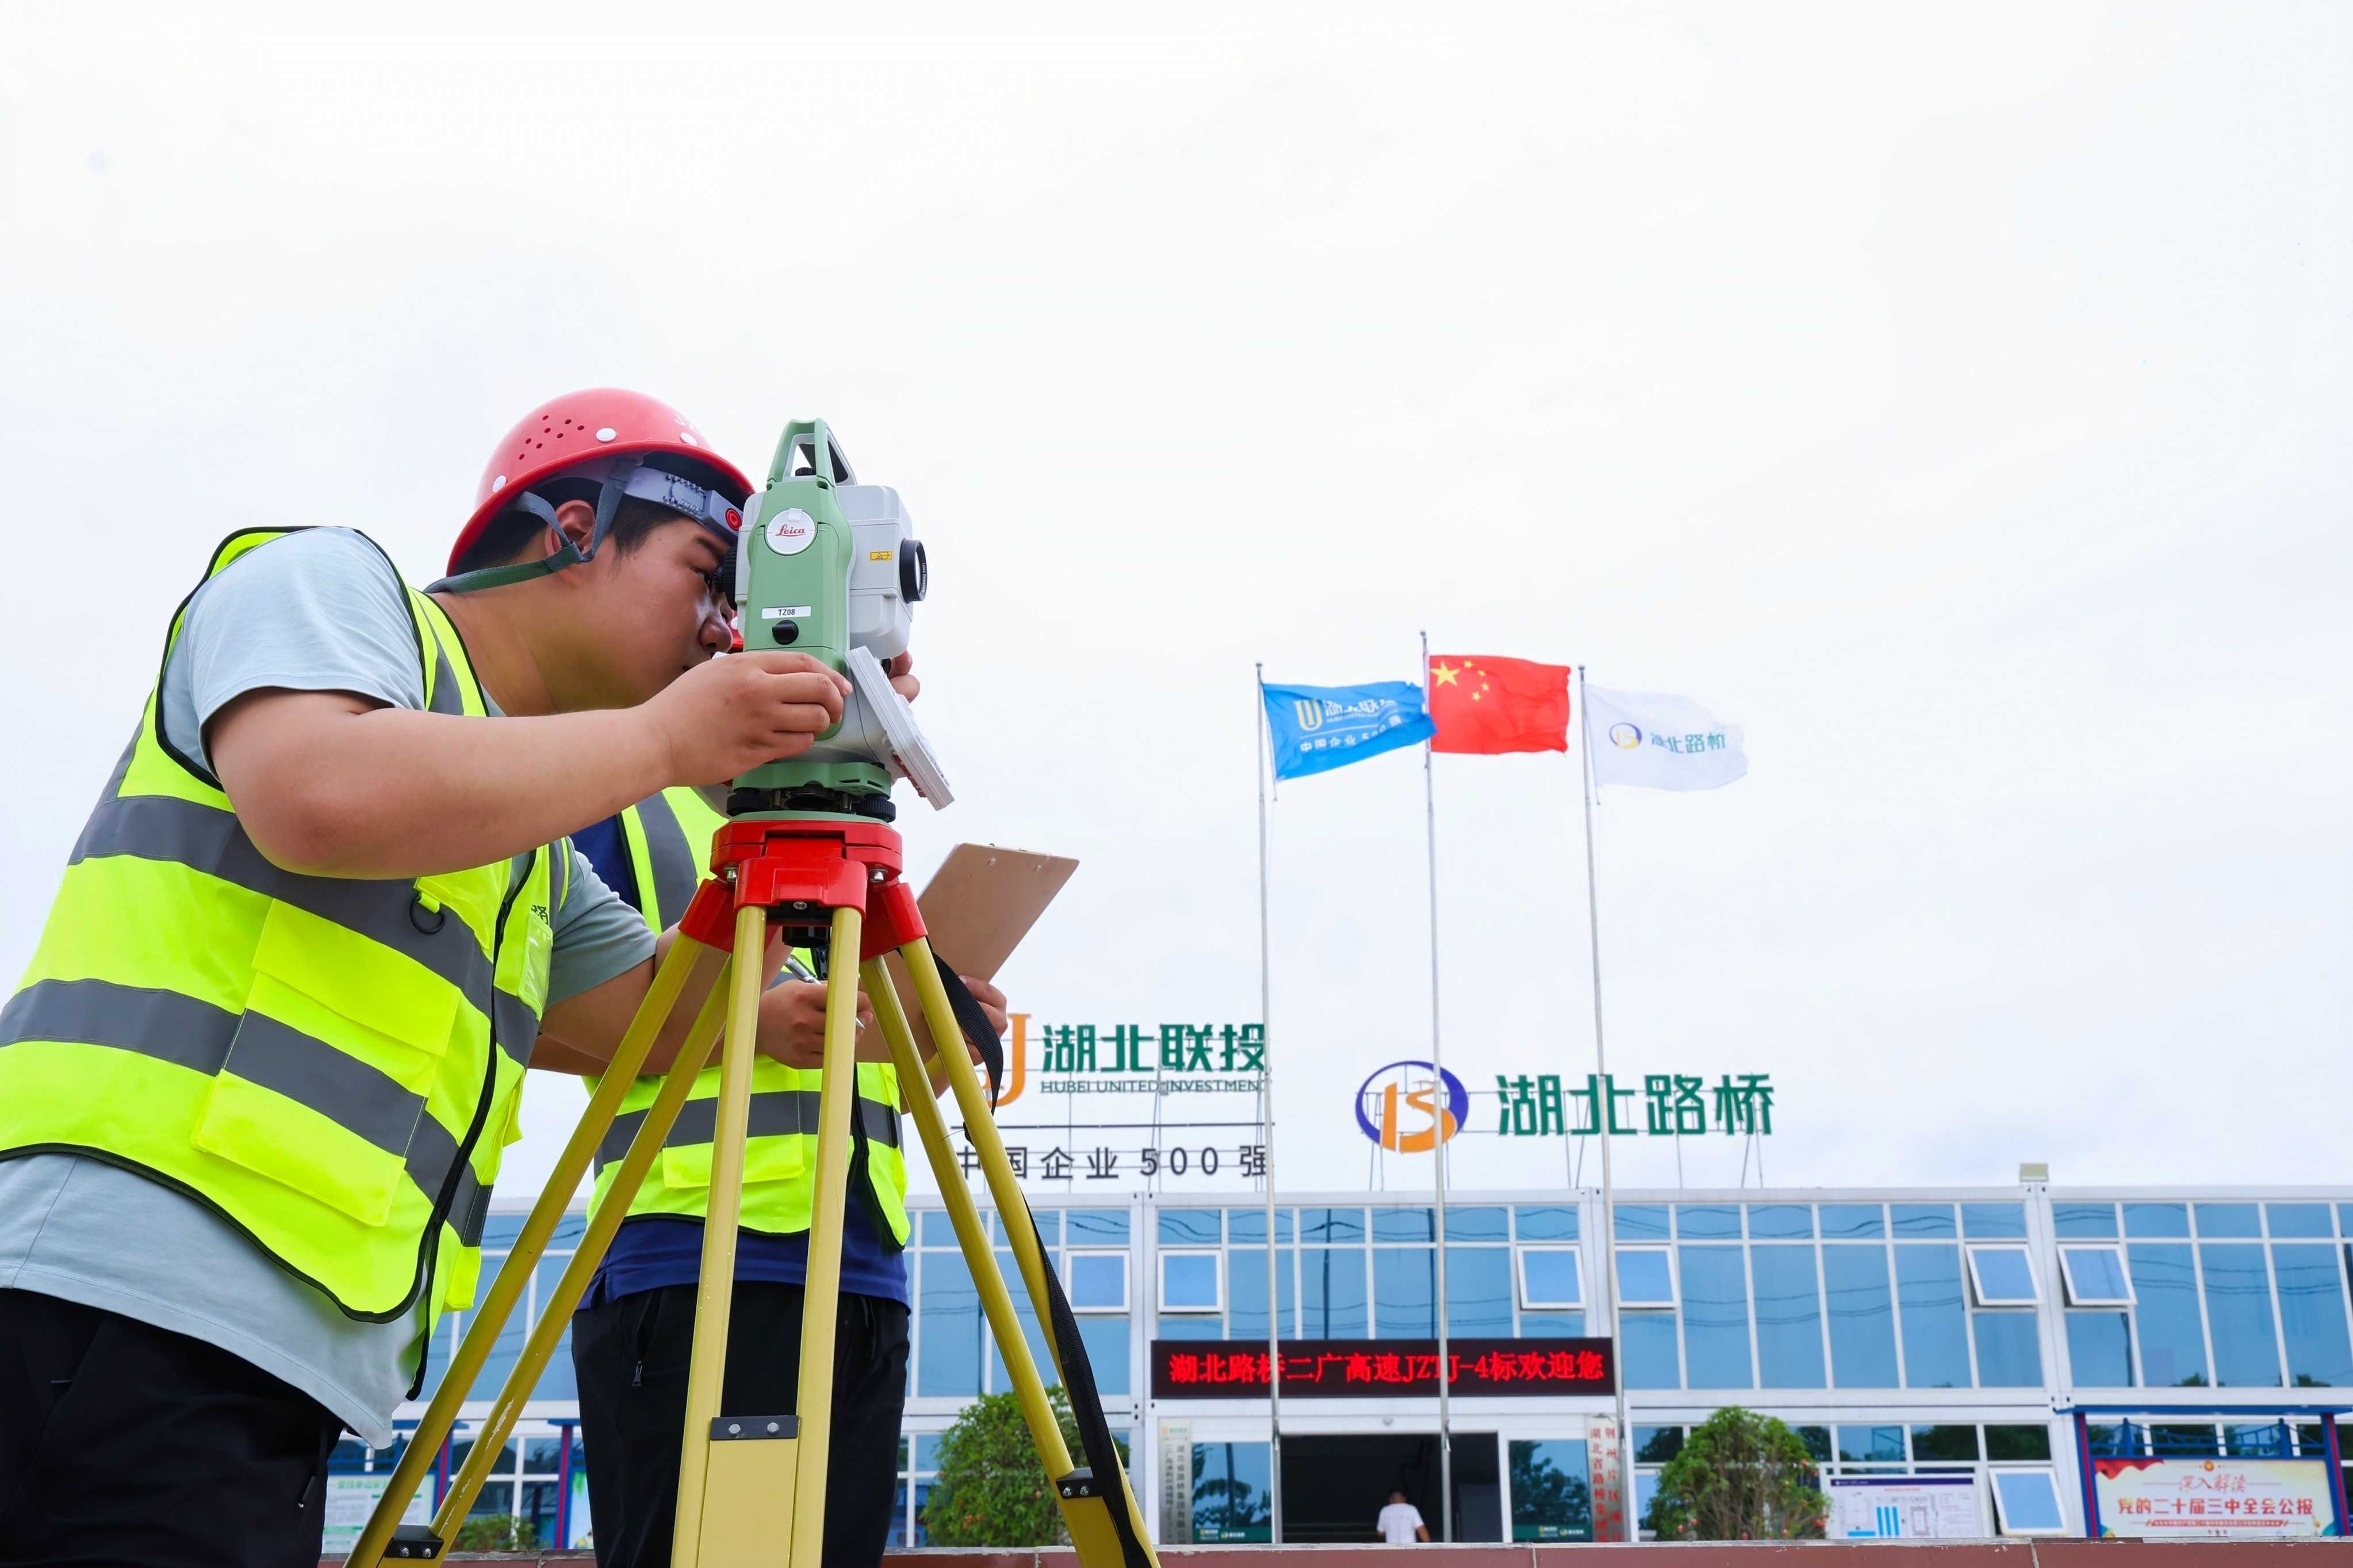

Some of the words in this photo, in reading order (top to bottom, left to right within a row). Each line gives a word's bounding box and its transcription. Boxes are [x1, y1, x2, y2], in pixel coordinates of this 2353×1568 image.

[775, 524, 806, 537] Leica
[1043, 1024, 1264, 1073] 湖北联投
[1041, 1081, 1091, 1092] HUBEI
[1097, 1080, 1159, 1092] UNITED
[1496, 1073, 1775, 1136] 湖北路桥
[2118, 1497, 2313, 1515] 党的二十届三中全会公报
